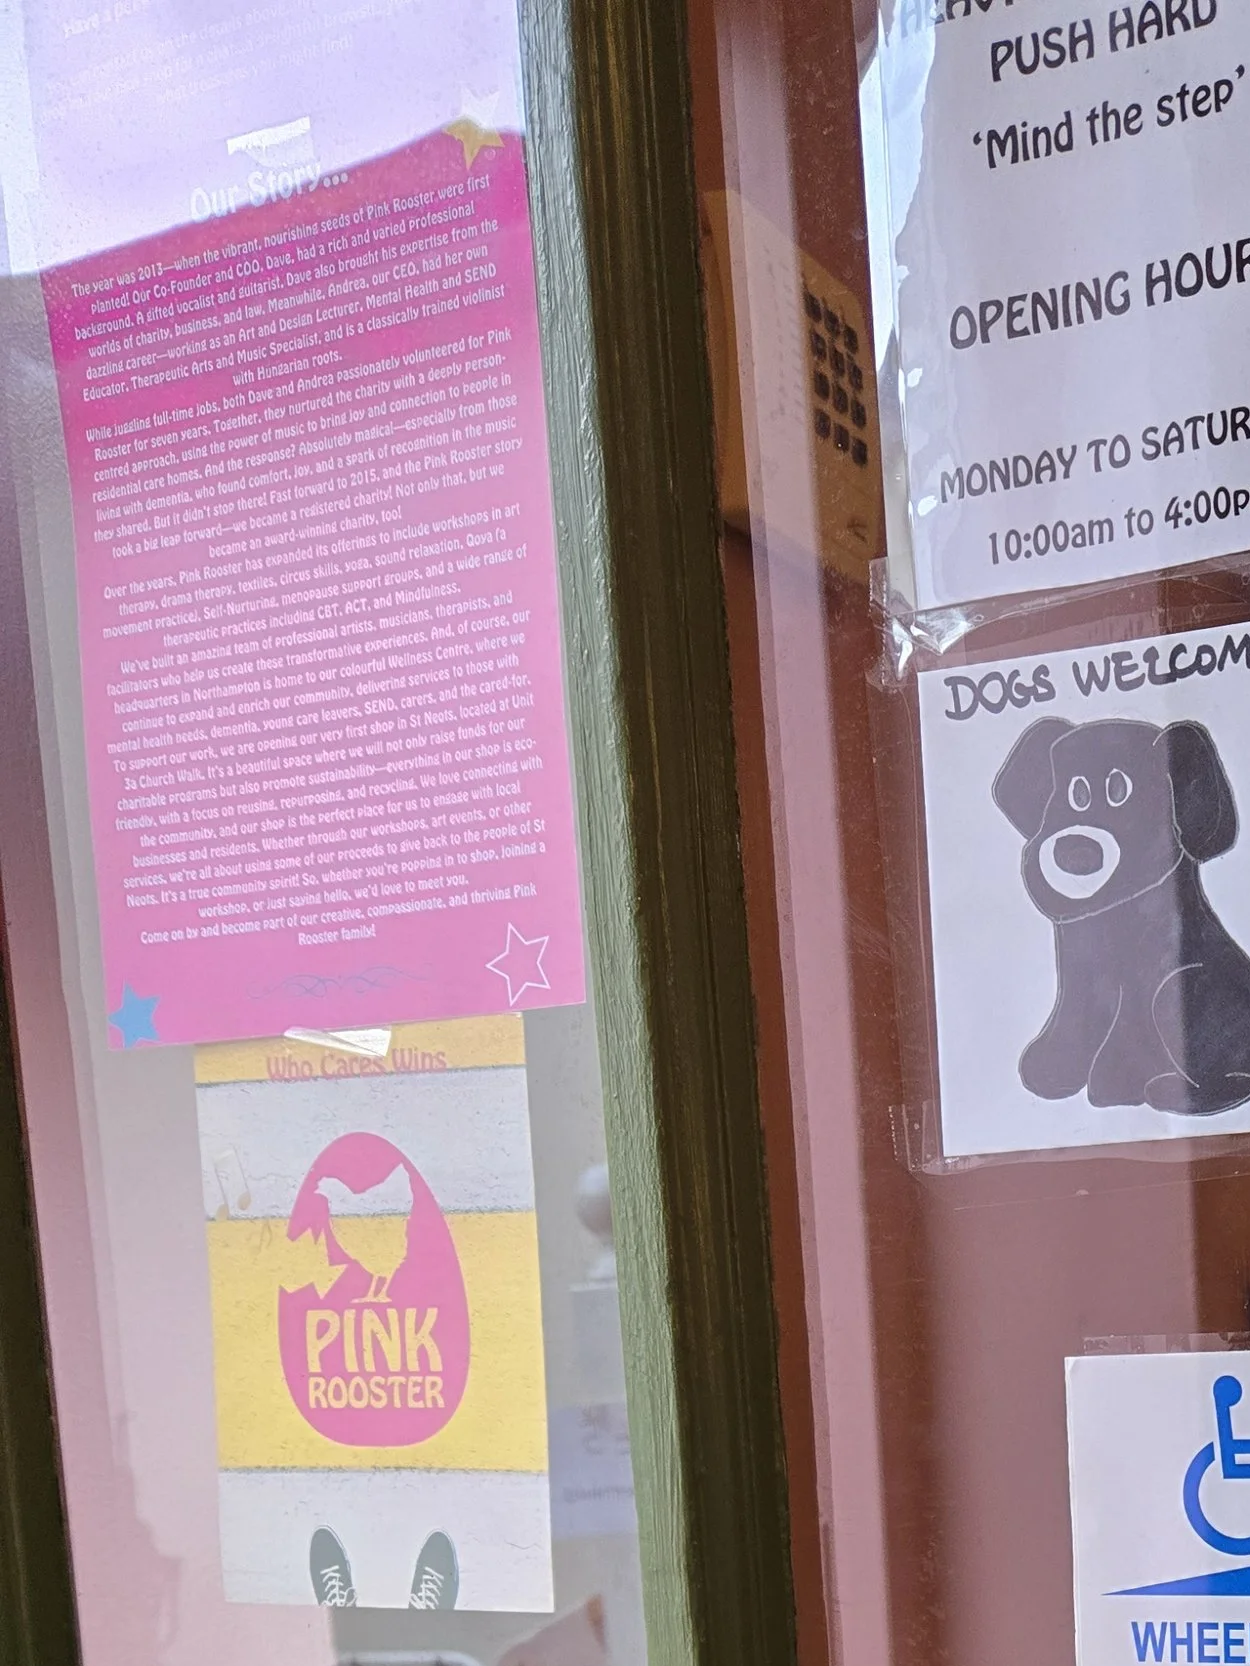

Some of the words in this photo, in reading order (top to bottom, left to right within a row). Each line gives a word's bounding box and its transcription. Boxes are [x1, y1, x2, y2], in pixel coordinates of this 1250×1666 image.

[991, 19, 1095, 82] PUSH
[1109, 0, 1217, 52] HARD
[1086, 101, 1143, 146] the
[189, 187, 239, 223] Our
[247, 163, 348, 206] Story...
[71, 280, 90, 299] The
[92, 277, 114, 293] year
[116, 271, 135, 287] was
[202, 246, 219, 265] the
[263, 220, 318, 248] nourishing
[320, 211, 350, 233] seeds
[352, 207, 364, 225] of
[366, 200, 389, 221] Pink
[392, 187, 434, 213] Rooster
[437, 182, 464, 201] were
[467, 172, 489, 193] first
[90, 291, 129, 315] planted!
[132, 286, 151, 305] Our
[153, 270, 212, 299] Co-Founder
[214, 264, 233, 284] and
[296, 242, 316, 262] had
[318, 243, 325, 256] a
[327, 234, 348, 254] rich
[351, 228, 370, 248] and
[372, 218, 405, 242] varied
[408, 199, 474, 231] professional
[135, 309, 144, 326] A
[146, 302, 174, 323] gifted
[176, 291, 214, 315] vocalist
[217, 286, 236, 305] and
[286, 266, 311, 287] Dave
[314, 259, 335, 279] also
[338, 248, 378, 273] brought
[381, 243, 397, 262] his
[399, 229, 448, 256] expertise
[451, 221, 477, 243] from
[480, 215, 498, 235] the
[950, 270, 1130, 349] OPENING
[85, 423, 111, 443] While
[113, 414, 150, 436] juggling
[152, 404, 193, 427] full-time
[222, 391, 245, 411] both
[247, 384, 273, 404] Dave
[275, 379, 294, 398] and
[296, 369, 333, 392] Andrea
[336, 353, 400, 382] passionately
[402, 337, 465, 366] volunteered
[468, 331, 484, 350] for
[487, 325, 511, 345] Pink
[232, 367, 254, 386] with
[256, 354, 309, 381] Hungarian
[94, 440, 131, 462] Rooster
[133, 435, 148, 453] for
[150, 431, 178, 449] seven
[263, 402, 286, 422] they
[288, 391, 333, 416] nurtured
[335, 386, 352, 405] the
[354, 377, 390, 400] charity
[393, 371, 415, 391] with
[418, 372, 424, 385] a
[427, 359, 462, 382] deeply
[465, 352, 505, 373] person-
[93, 525, 114, 543] they
[153, 512, 170, 530] But
[172, 510, 180, 526] it
[212, 498, 234, 517] stop
[237, 491, 267, 512] there!
[269, 486, 291, 505] Fast
[294, 476, 334, 499] forward
[336, 473, 347, 490] to
[382, 461, 401, 480] and
[404, 457, 421, 475] the
[424, 451, 447, 471] Pink
[450, 441, 491, 464] Rooster
[494, 434, 522, 455] story
[939, 444, 1078, 503] MONDAY
[1087, 434, 1131, 472] TO
[103, 581, 127, 600] Over
[129, 578, 145, 595] the
[179, 567, 201, 585] Pink
[203, 558, 242, 580] Rooster
[245, 554, 263, 572] has
[265, 544, 313, 568] expanded
[315, 541, 328, 558] its
[330, 531, 376, 554] offerings
[379, 528, 390, 545] to
[392, 520, 429, 542] include
[431, 507, 488, 533] workshops
[491, 504, 501, 521] in
[504, 500, 520, 519] art
[988, 517, 1114, 564] 10:00am
[1125, 506, 1154, 535] to
[163, 624, 218, 648] therapeutic
[220, 615, 267, 638] practices
[269, 606, 314, 629] including
[373, 591, 392, 610] and
[944, 664, 1056, 720] DOGS
[112, 757, 126, 772] To
[128, 751, 167, 771] support
[169, 751, 187, 765] our
[220, 745, 234, 758] we
[237, 742, 254, 755] are
[257, 732, 297, 753] opening
[299, 732, 317, 746] our
[320, 728, 343, 743] very
[345, 721, 367, 739] first
[369, 716, 394, 735] shop
[396, 714, 407, 730] in
[409, 712, 421, 728] St
[459, 698, 496, 719] located
[499, 696, 509, 712] at
[511, 691, 534, 710] Unit
[297, 927, 338, 946] Rooster
[265, 1056, 313, 1082] Who
[320, 1052, 388, 1078] Cares
[393, 1048, 447, 1072] Wins
[305, 1307, 444, 1374] PINK
[308, 1376, 445, 1410] ROOSTER
